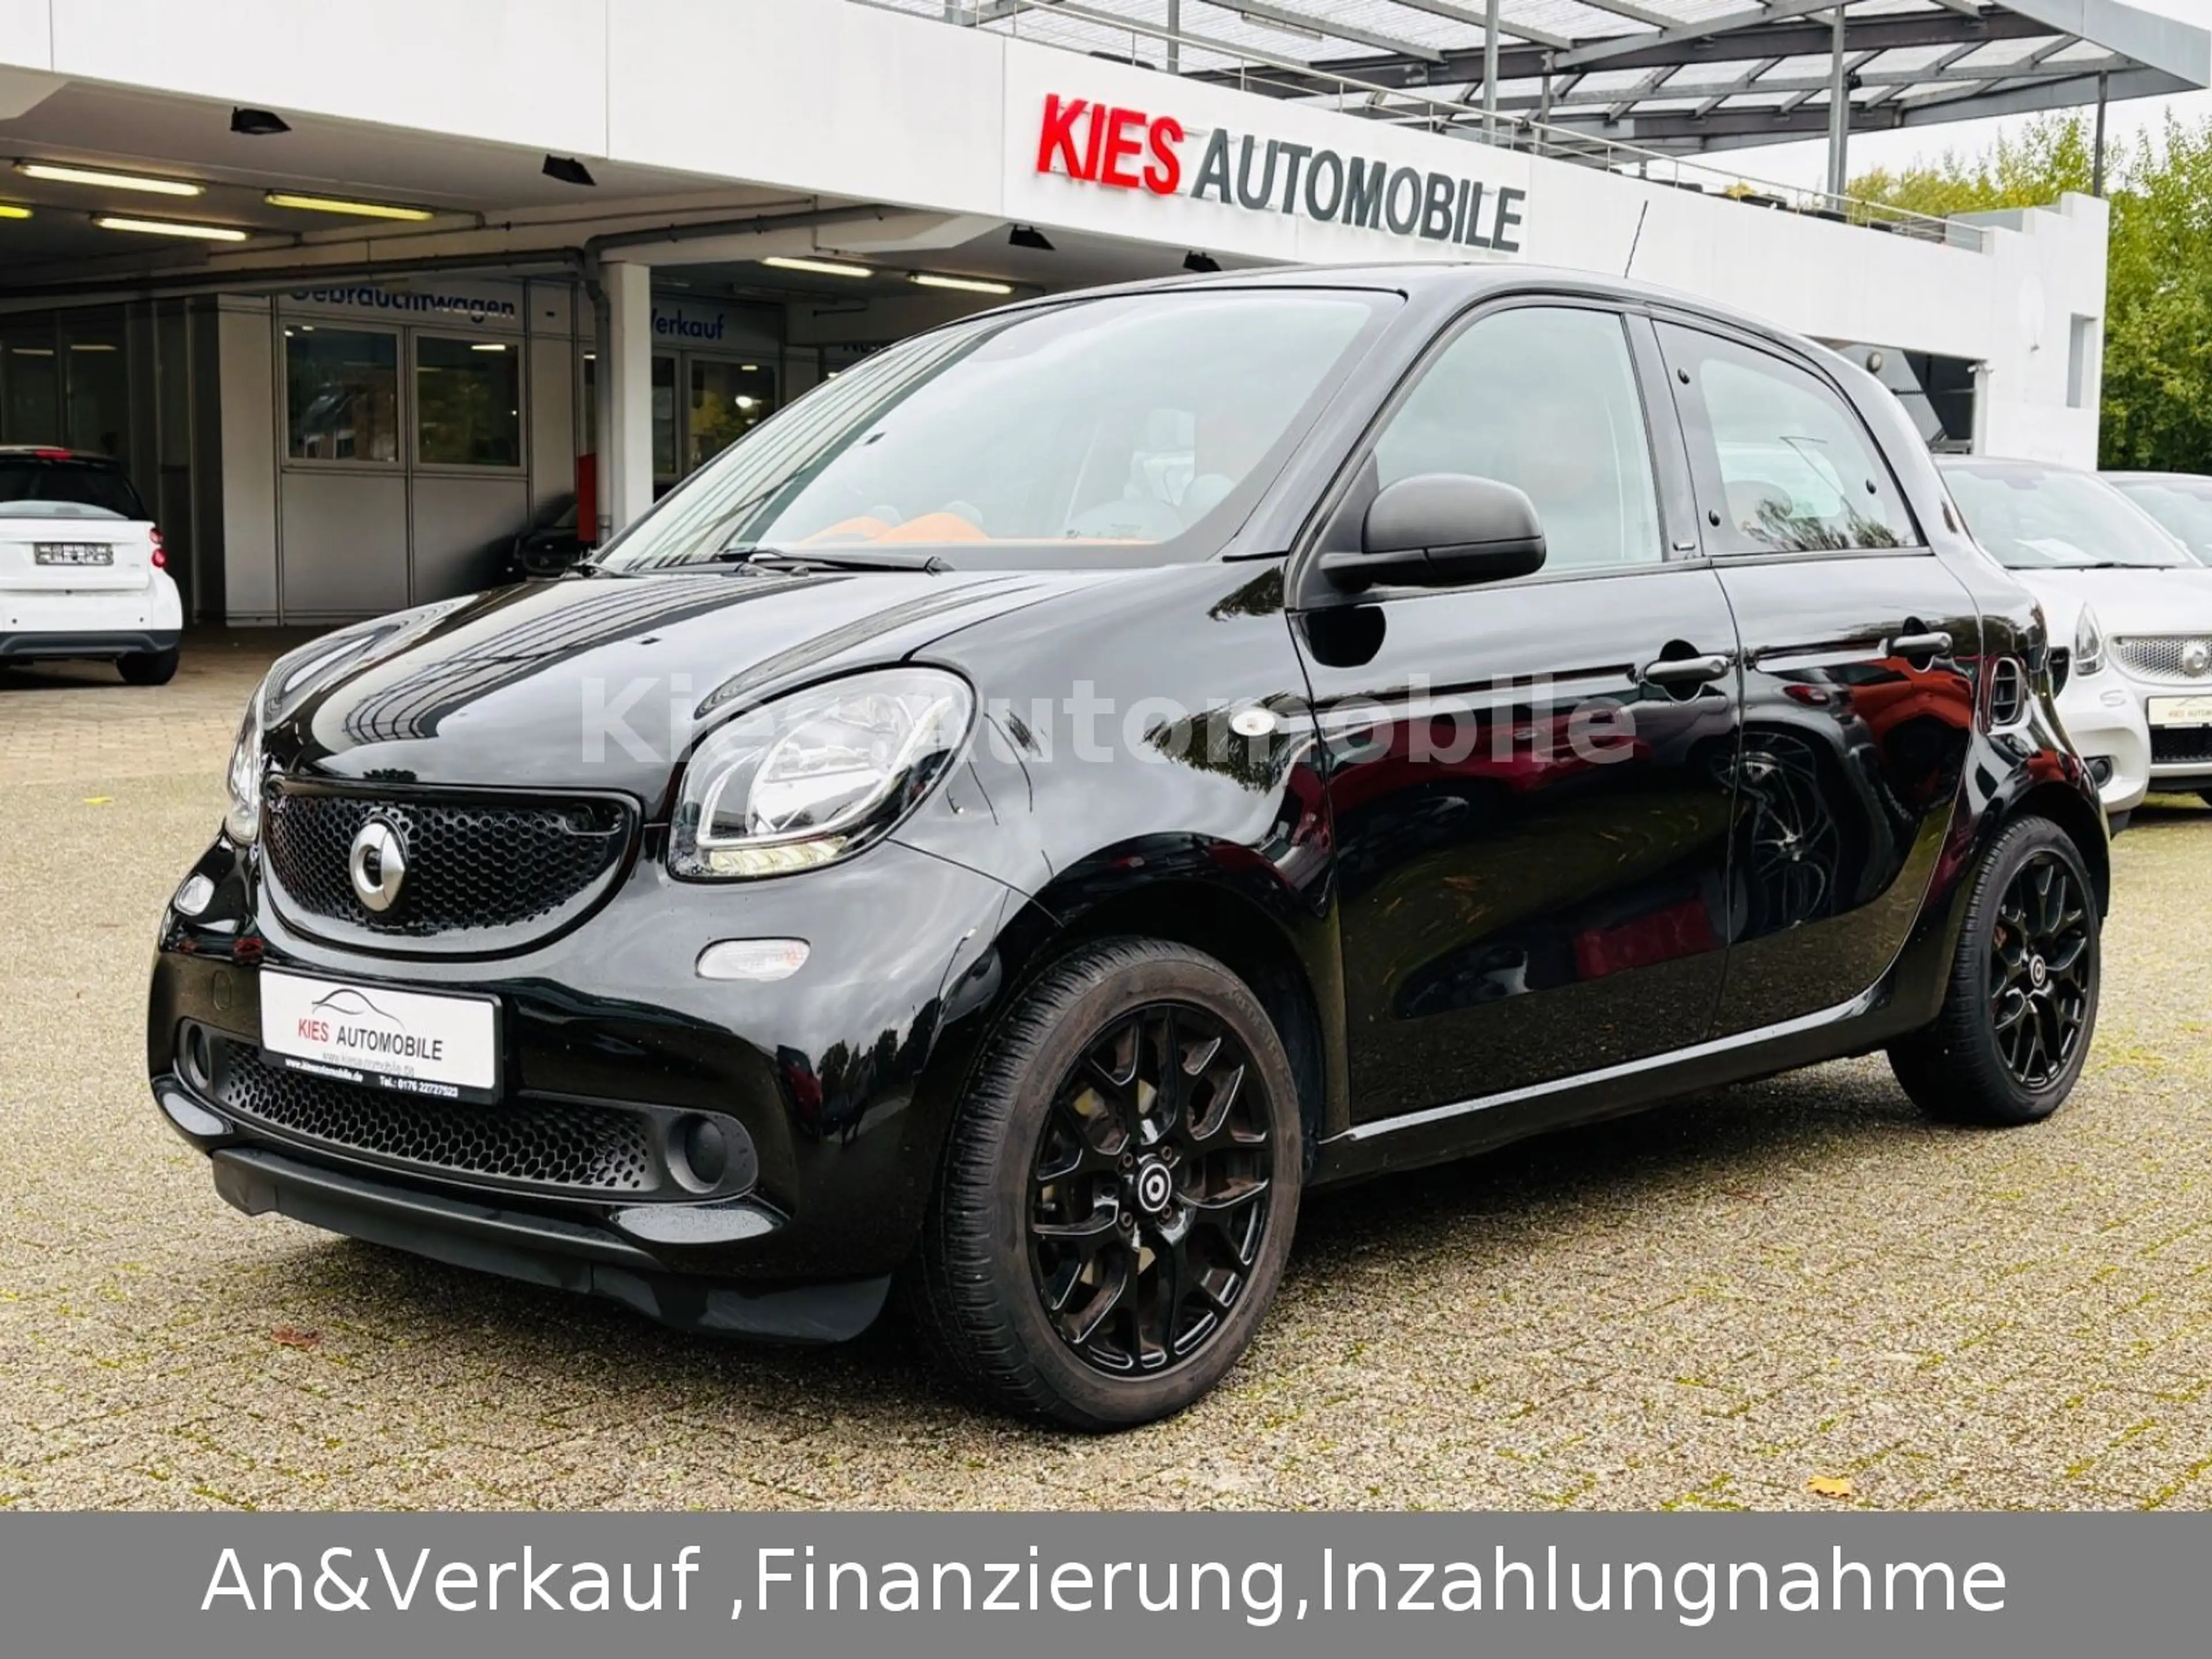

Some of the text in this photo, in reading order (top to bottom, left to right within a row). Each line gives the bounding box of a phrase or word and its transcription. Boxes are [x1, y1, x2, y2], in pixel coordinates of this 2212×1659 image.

[1037, 93, 1526, 252] KIES AUTOMOBILE
[297, 1018, 444, 1061] KIES AUTOMOBILE
